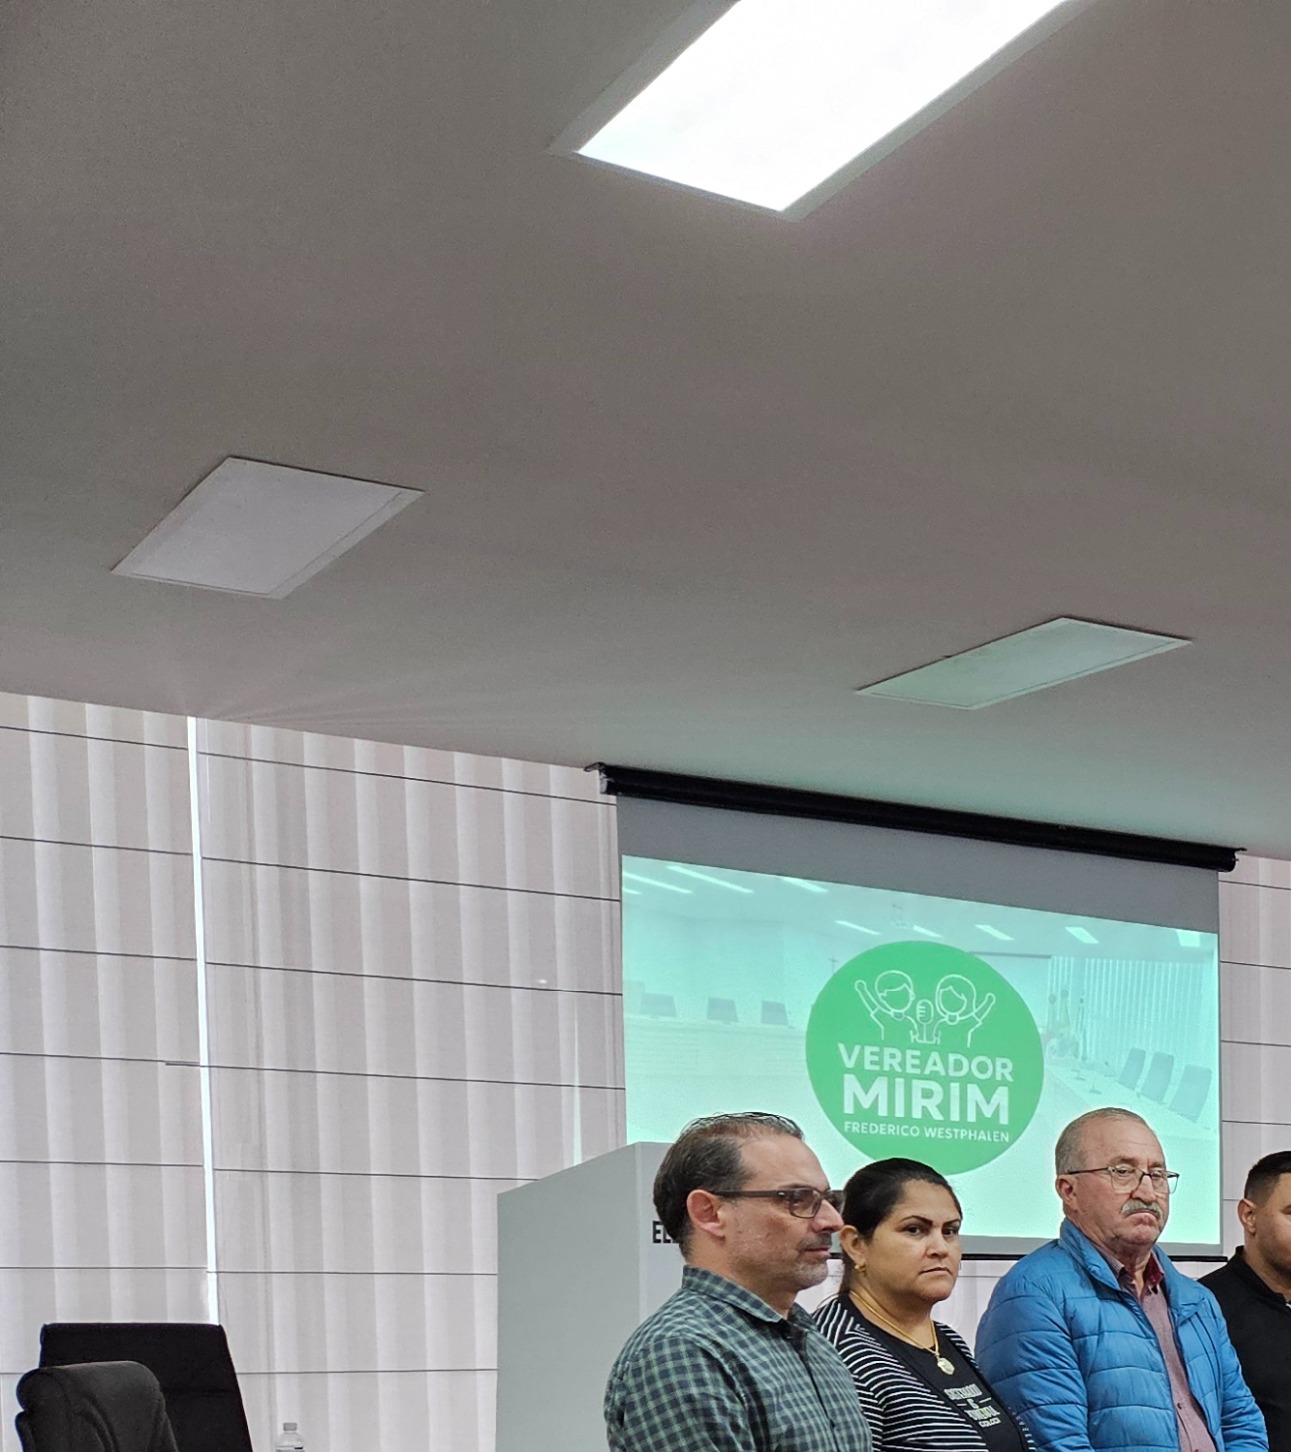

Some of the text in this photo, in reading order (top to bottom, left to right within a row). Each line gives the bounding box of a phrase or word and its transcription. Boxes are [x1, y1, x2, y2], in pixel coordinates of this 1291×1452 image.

[837, 1042, 1014, 1082] VEREADOR
[843, 1073, 1009, 1125] MIRIM
[843, 1121, 1010, 1142] FREDERICO WESTPHALEN
